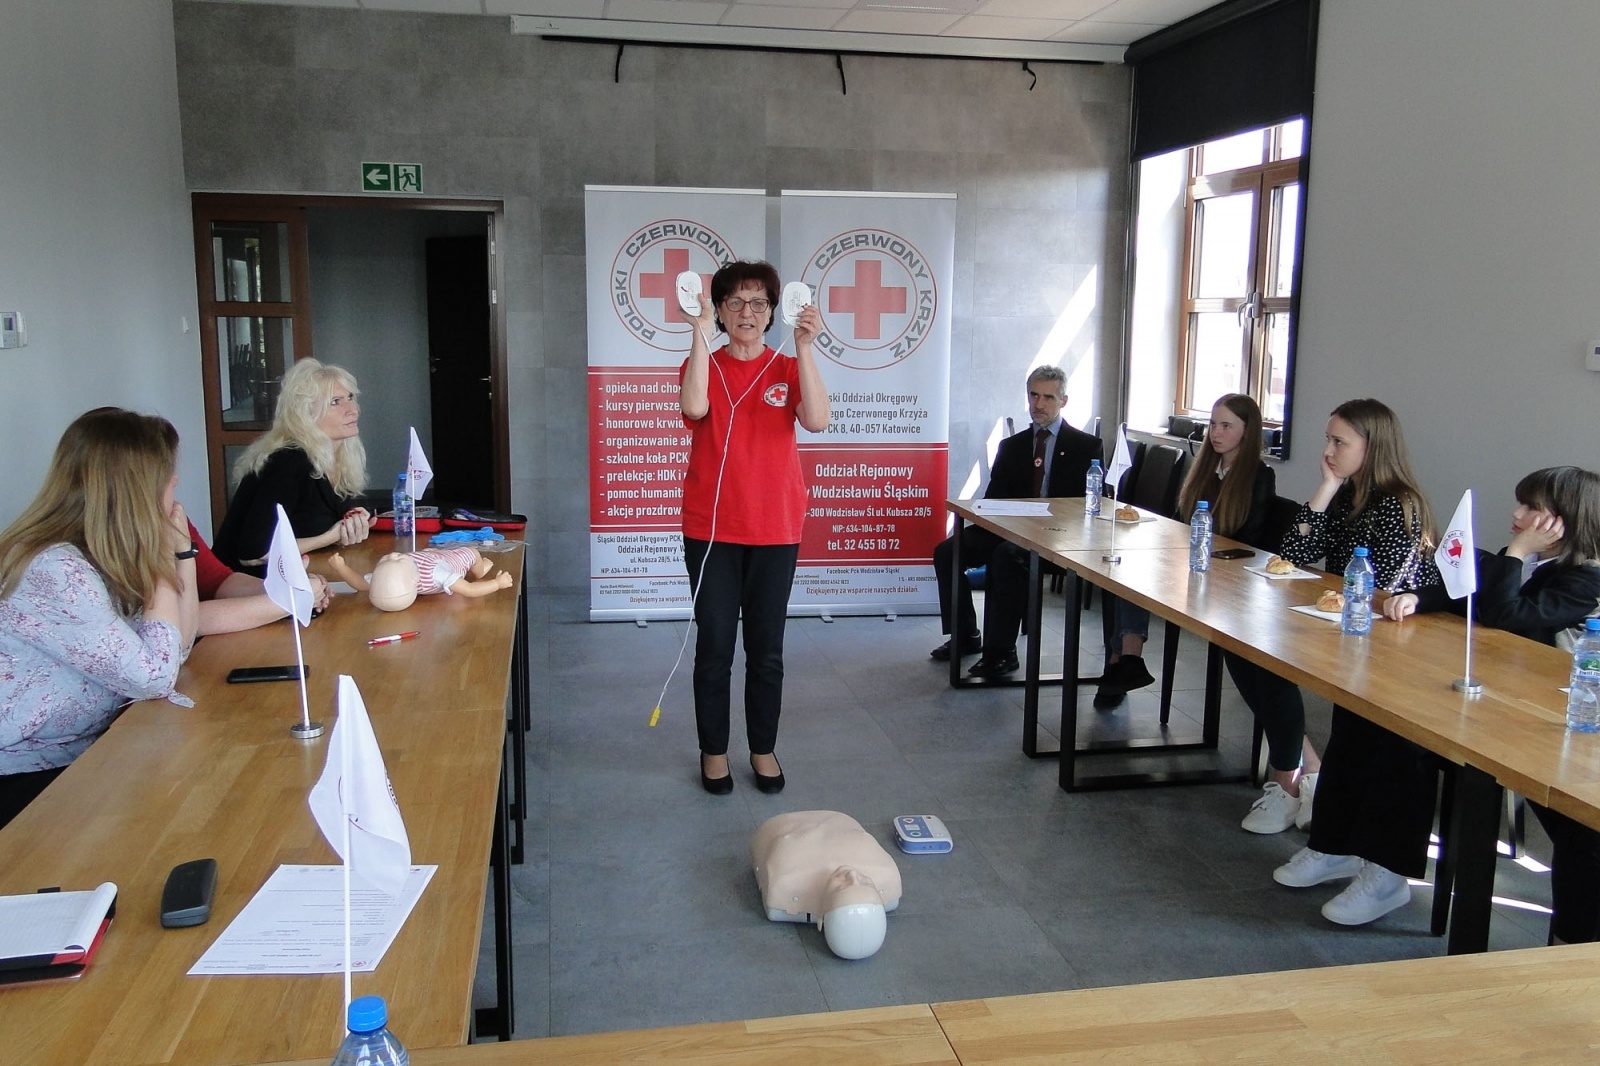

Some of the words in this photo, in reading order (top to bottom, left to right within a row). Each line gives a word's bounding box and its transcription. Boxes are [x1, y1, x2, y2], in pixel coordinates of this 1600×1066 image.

[625, 224, 734, 269] CZERWONY
[815, 233, 929, 279] CZERWONY
[889, 289, 932, 359] KRZYŻ
[615, 270, 656, 340] POLSKI
[605, 382, 638, 396] opieka
[640, 382, 658, 393] nad
[842, 392, 874, 403] Oddział
[875, 392, 918, 405] Okręgowy
[606, 399, 633, 414] kursy
[846, 408, 898, 420] Czerwonego
[899, 407, 928, 420] Krzyża
[606, 417, 654, 429] honorowe
[656, 417, 686, 429] krwio
[840, 424, 848, 434] 8,
[850, 424, 880, 434] 40-057
[882, 423, 921, 434] Katowice
[606, 435, 678, 449] organizowanie
[606, 452, 644, 464] szkolne
[646, 452, 667, 464] koła
[669, 451, 689, 464] PCK
[607, 469, 655, 484] prelekcje:
[657, 469, 676, 481] HDK
[815, 463, 858, 477] Oddział
[859, 464, 914, 480] Rejonowy
[607, 490, 639, 502] pomoc
[812, 485, 881, 499] Wodzisławiu
[883, 481, 929, 501] Śląskim
[607, 505, 634, 519] akcje
[635, 504, 682, 519] prozdrow
[804, 508, 824, 517] -300
[825, 507, 865, 517] Wodzisław
[886, 507, 913, 517] Kubsza
[914, 506, 931, 517] 28/5
[832, 525, 845, 533] NIP:
[597, 535, 615, 545] Śląski
[616, 535, 638, 543] Oddział
[639, 535, 669, 544] Okręgowy
[827, 540, 843, 550] tel.
[844, 540, 856, 550] 32
[857, 539, 875, 550] 455
[877, 539, 887, 550] 18
[889, 539, 900, 549] 72
[617, 545, 643, 554] Oddział
[644, 545, 677, 555] Rejonowy
[806, 587, 838, 595] Dziękujemy
[847, 586, 872, 595] wsparcie
[873, 586, 896, 594] naszych
